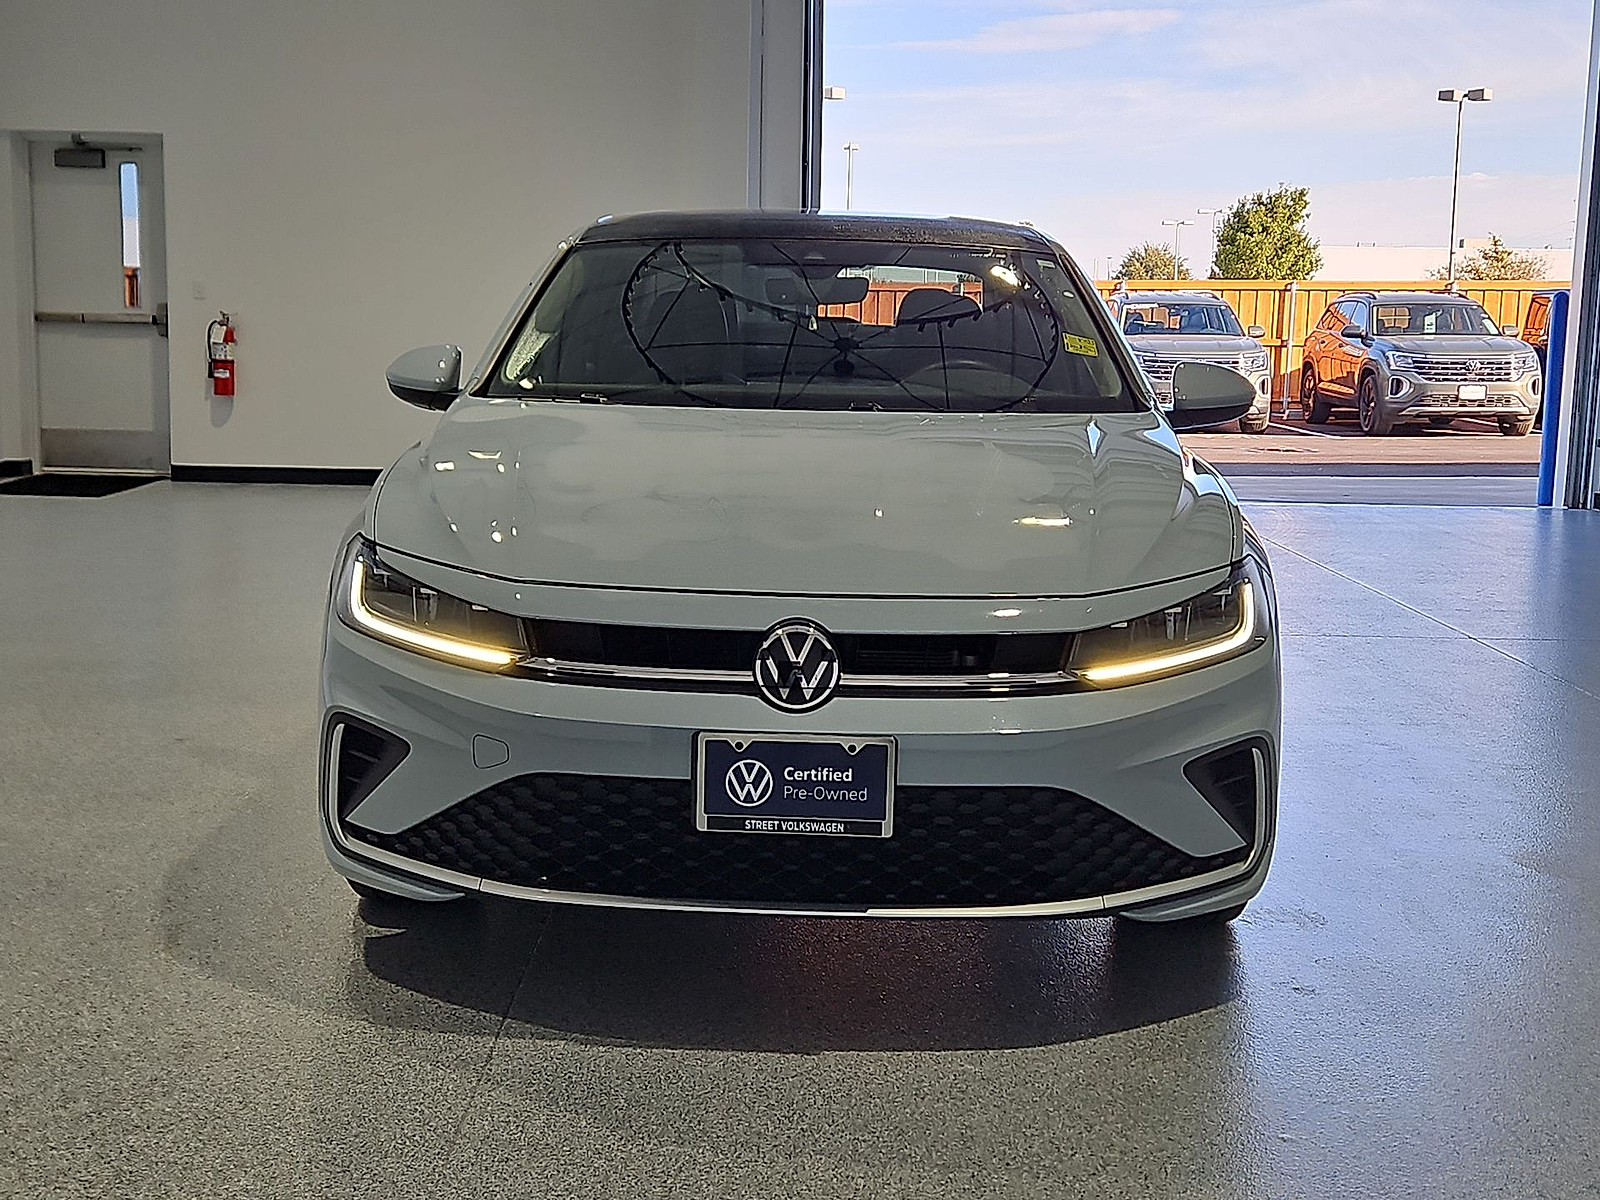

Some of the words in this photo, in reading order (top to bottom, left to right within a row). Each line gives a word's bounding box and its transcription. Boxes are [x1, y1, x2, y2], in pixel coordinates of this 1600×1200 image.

[757, 627, 837, 708] VW
[783, 767, 853, 782] Certified
[726, 760, 773, 807] VW
[783, 785, 868, 801] Pre-Owned
[744, 820, 779, 831] STREET
[781, 821, 845, 833] VOLKSWAGEN
